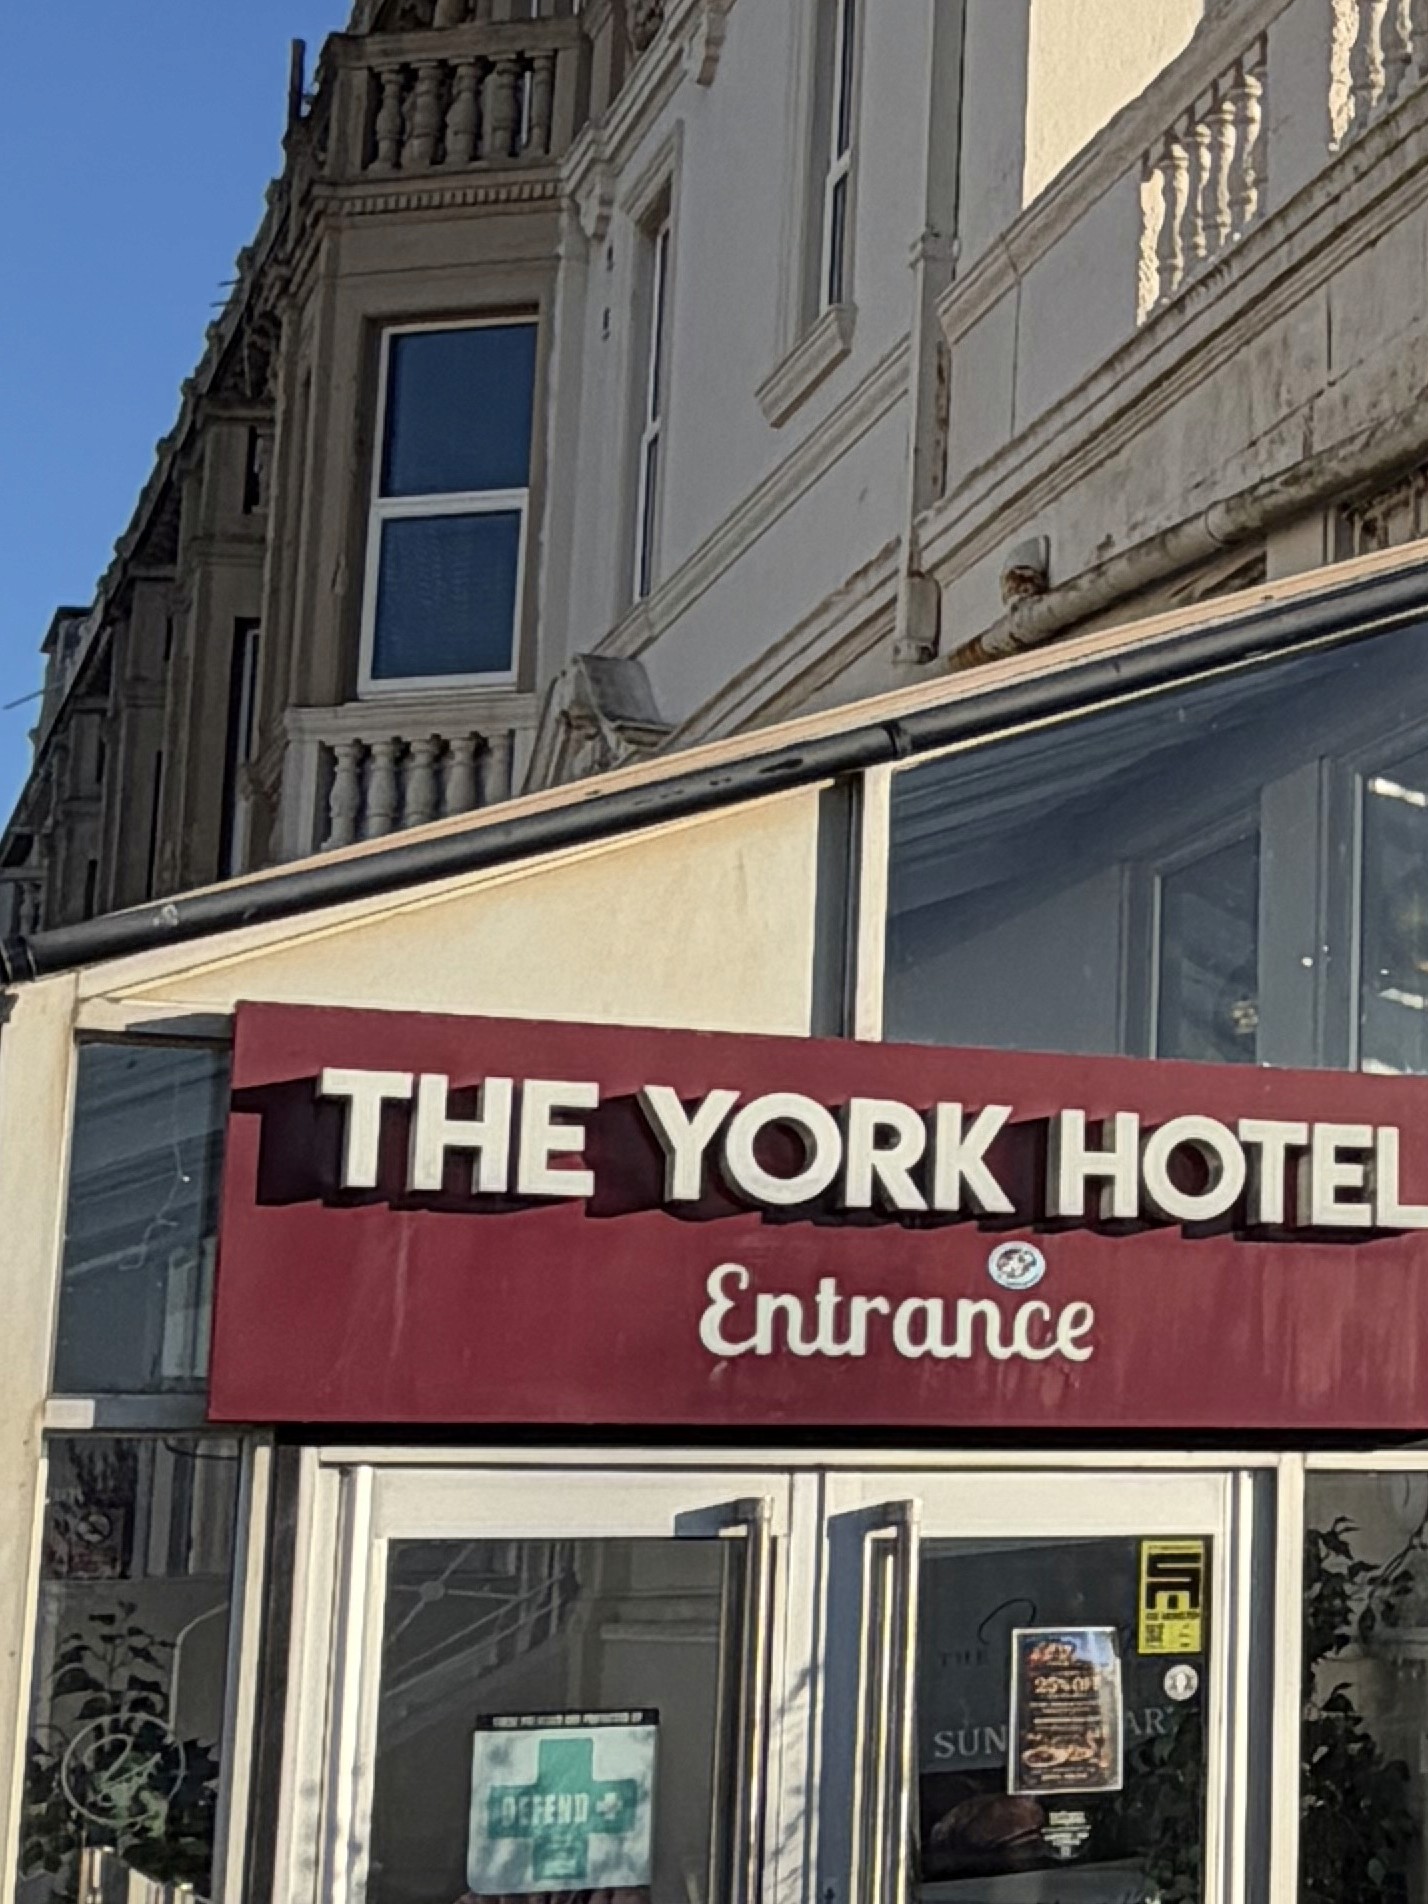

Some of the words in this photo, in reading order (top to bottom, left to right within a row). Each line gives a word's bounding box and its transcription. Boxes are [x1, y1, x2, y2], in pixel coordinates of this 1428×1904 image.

[318, 1067, 599, 1199] THE
[641, 1083, 1017, 1215] YORK
[698, 1262, 1096, 1363] Entrance
